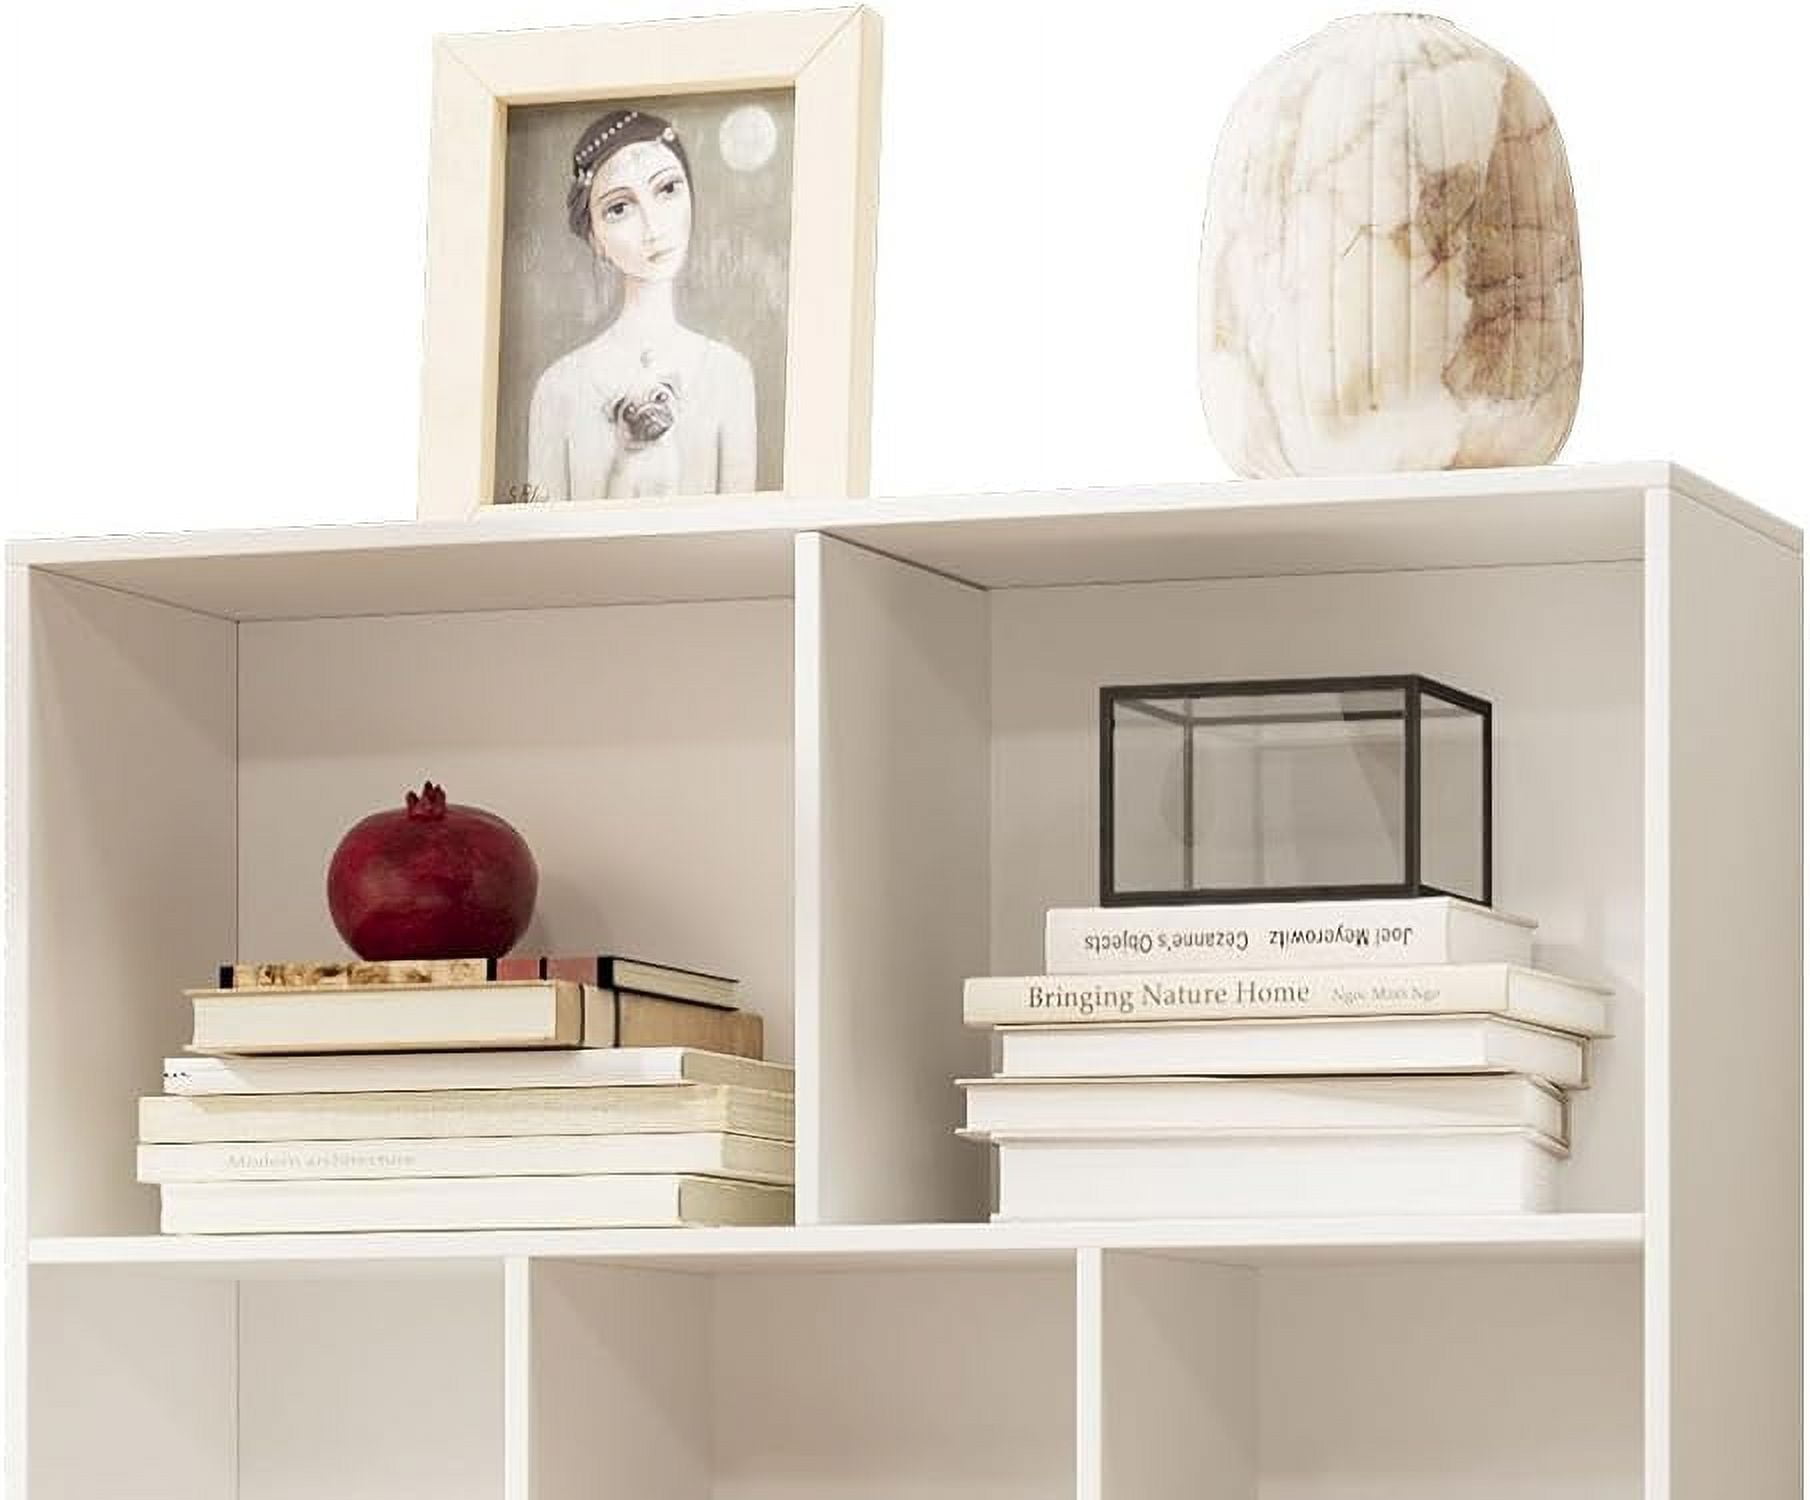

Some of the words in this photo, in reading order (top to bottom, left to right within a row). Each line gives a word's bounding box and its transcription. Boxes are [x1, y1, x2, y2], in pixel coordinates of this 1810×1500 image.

[1084, 929, 1152, 954] Objects
[1268, 922, 1369, 949] Meyerowitz
[1376, 927, 1413, 946] Joel
[1029, 986, 1135, 1014] Bringing
[1143, 983, 1228, 1006] Nature
[1238, 980, 1310, 1003] Home
